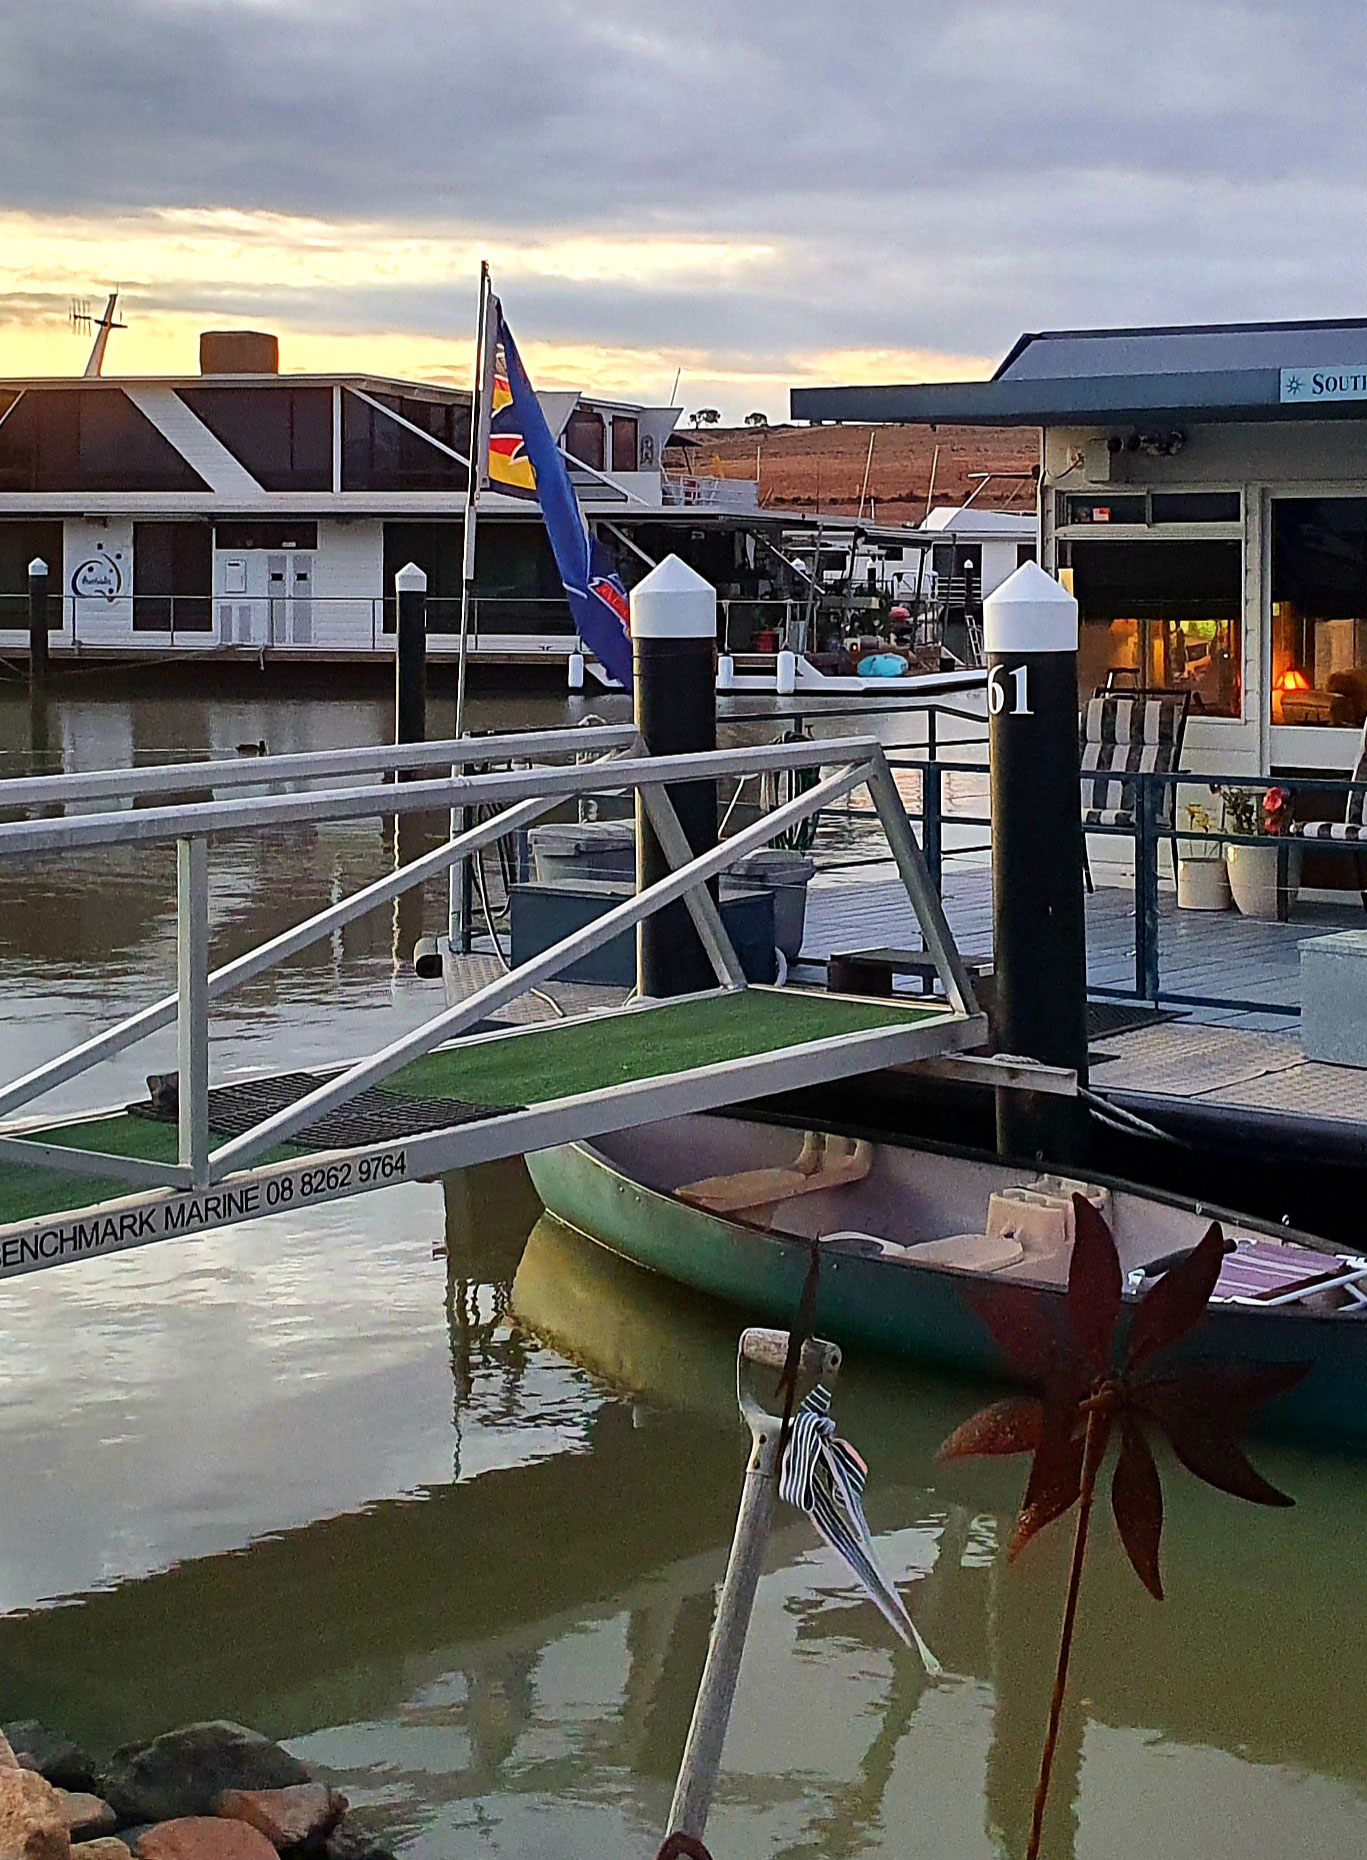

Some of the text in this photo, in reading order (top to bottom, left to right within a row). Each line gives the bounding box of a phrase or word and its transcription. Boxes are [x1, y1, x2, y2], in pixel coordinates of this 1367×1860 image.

[988, 664, 1034, 715] 61
[0, 1151, 406, 1267] ENCHMARK MARINE 08 8262 9764
